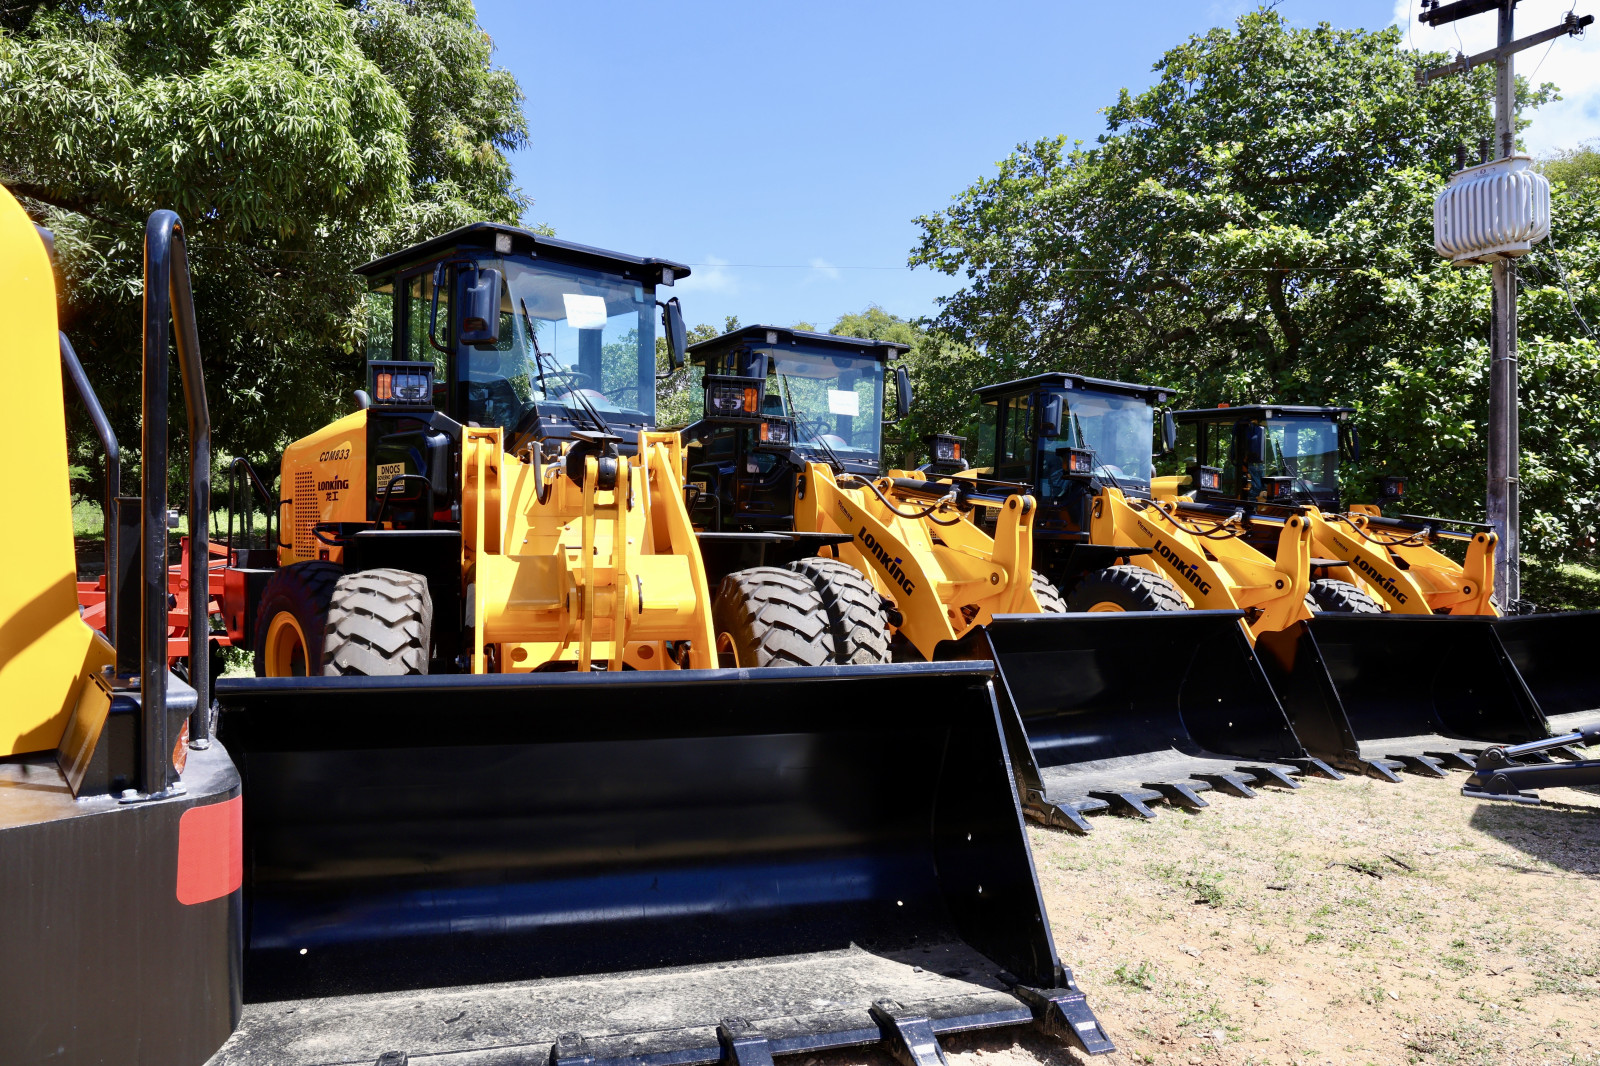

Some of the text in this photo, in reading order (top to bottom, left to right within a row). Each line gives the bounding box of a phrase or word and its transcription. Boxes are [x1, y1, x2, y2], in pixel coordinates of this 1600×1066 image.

[319, 449, 350, 462] CDM833
[381, 464, 401, 475] DNOCS
[318, 475, 349, 491] LONKING
[858, 525, 915, 596] LONKING
[1153, 539, 1212, 596] LONKING
[1352, 555, 1408, 605] LONKING
